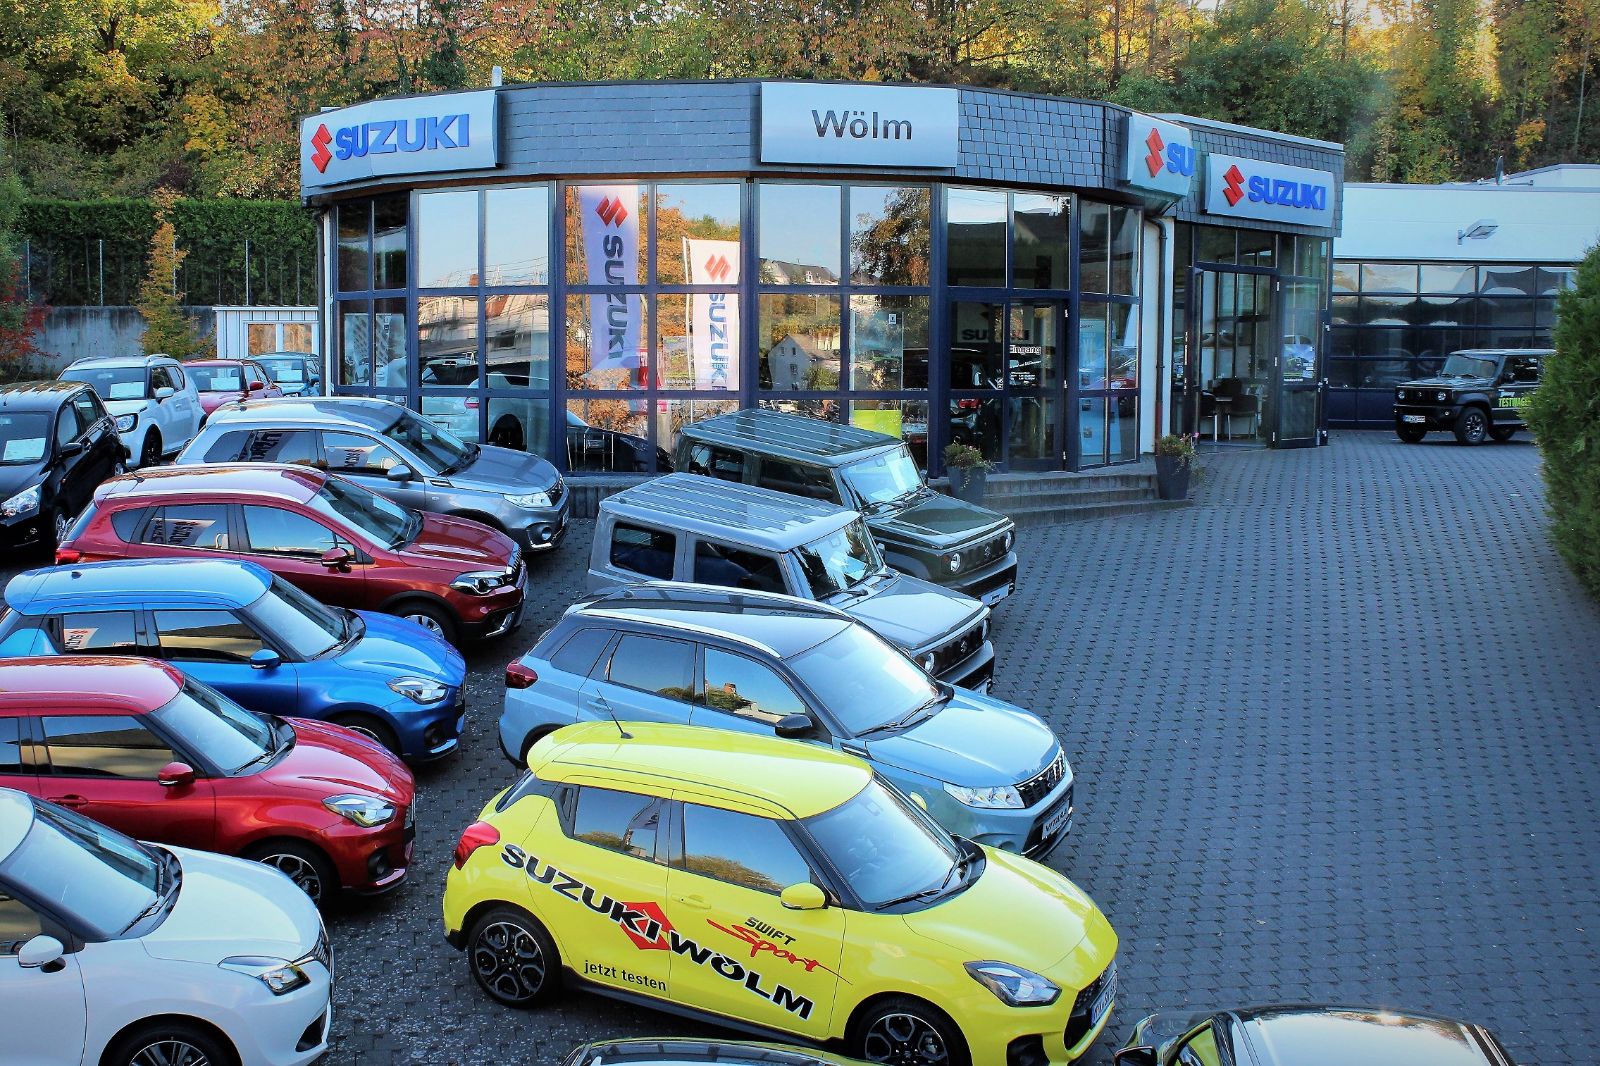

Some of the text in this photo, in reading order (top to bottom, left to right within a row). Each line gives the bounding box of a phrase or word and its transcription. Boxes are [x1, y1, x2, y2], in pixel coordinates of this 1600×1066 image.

[335, 114, 470, 160] SUZUKI
[811, 109, 913, 141] Wölm
[1248, 175, 1326, 210] SUZUKI
[603, 234, 628, 360] SUZUKI
[500, 843, 662, 943] SUZUKI
[706, 918, 840, 978] Sport
[744, 916, 797, 946] SWIFT
[583, 960, 667, 991] jetzt testen
